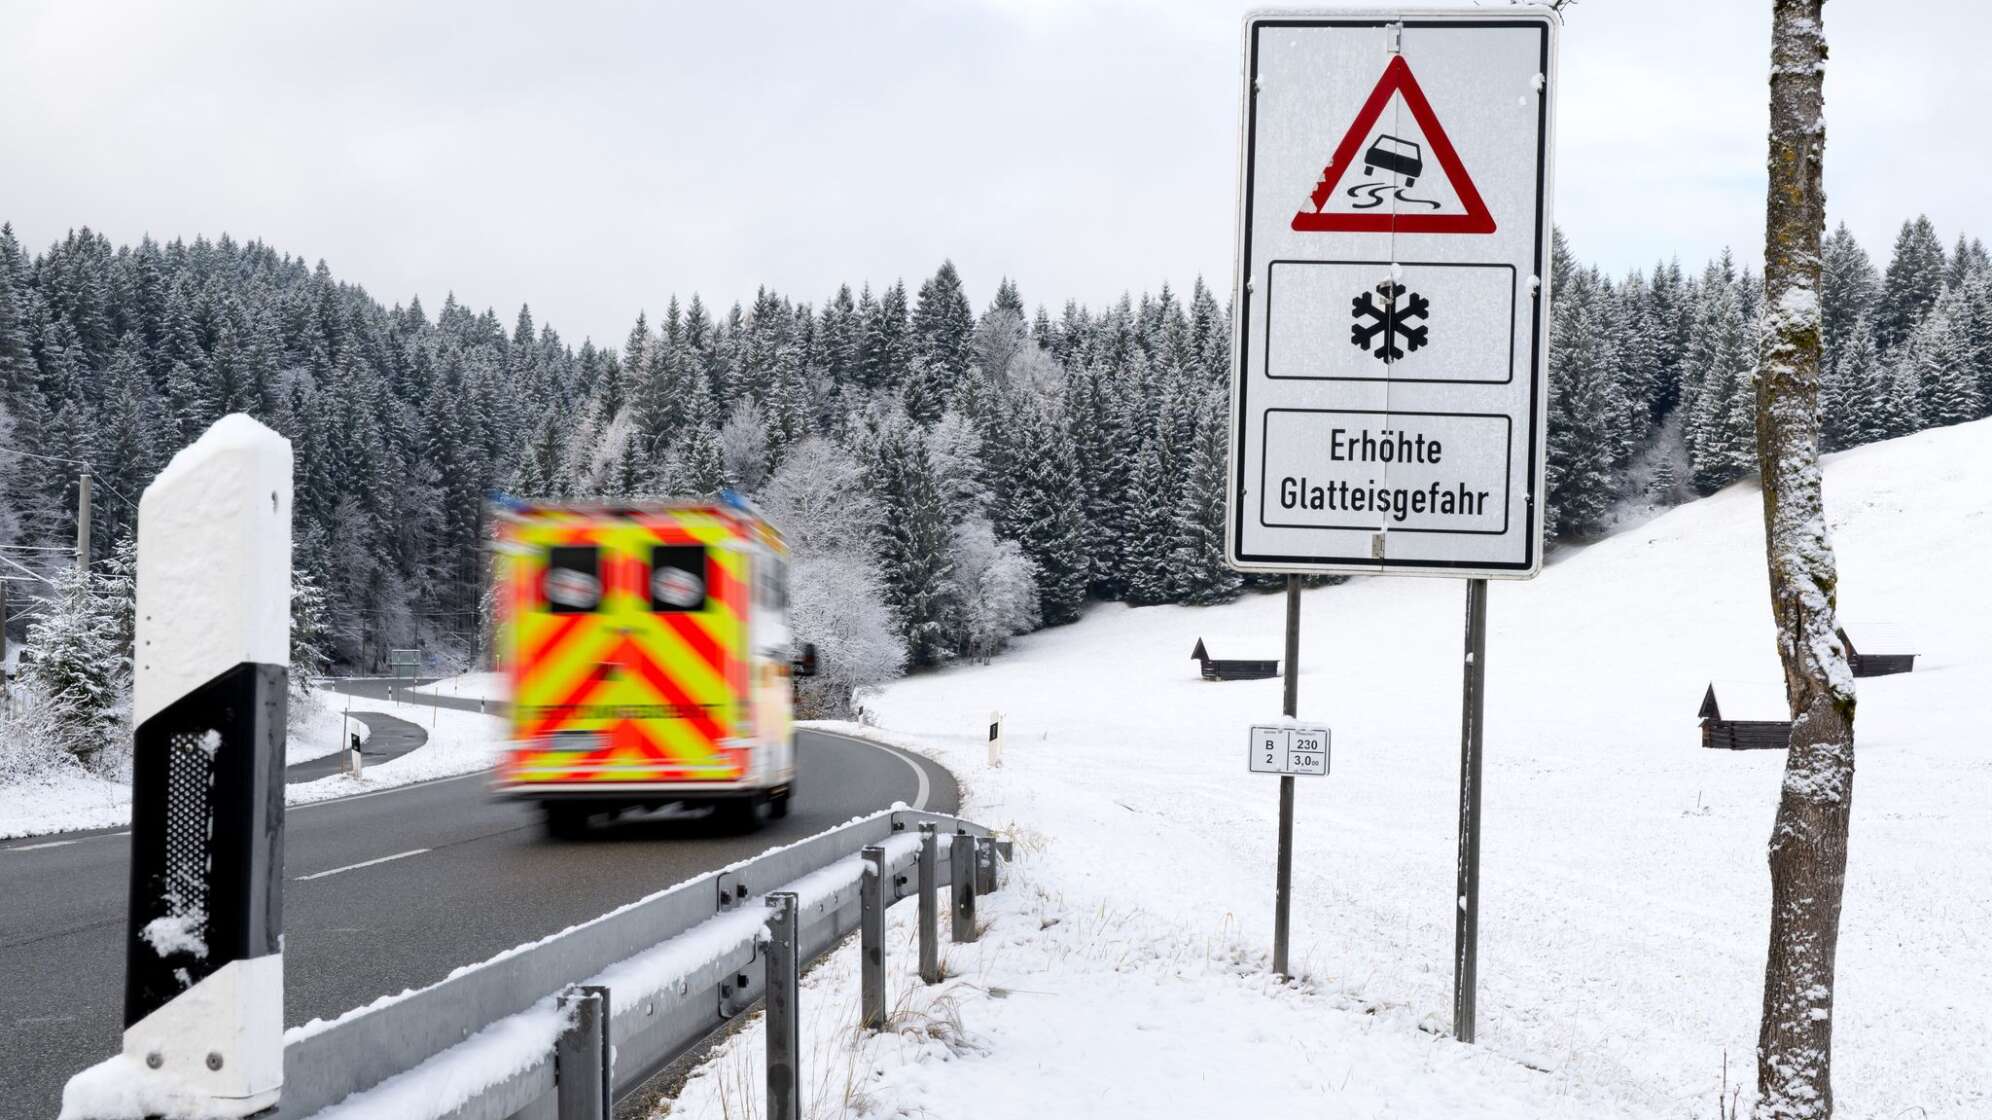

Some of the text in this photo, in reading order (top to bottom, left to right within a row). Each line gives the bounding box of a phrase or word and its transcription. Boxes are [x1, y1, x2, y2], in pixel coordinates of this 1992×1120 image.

[1330, 428, 1442, 464] Erhöhte
[1281, 477, 1489, 521] Glatteisgefahr
[1265, 740, 1274, 750] B
[1297, 739, 1318, 750] 230
[1266, 753, 1273, 764] 2
